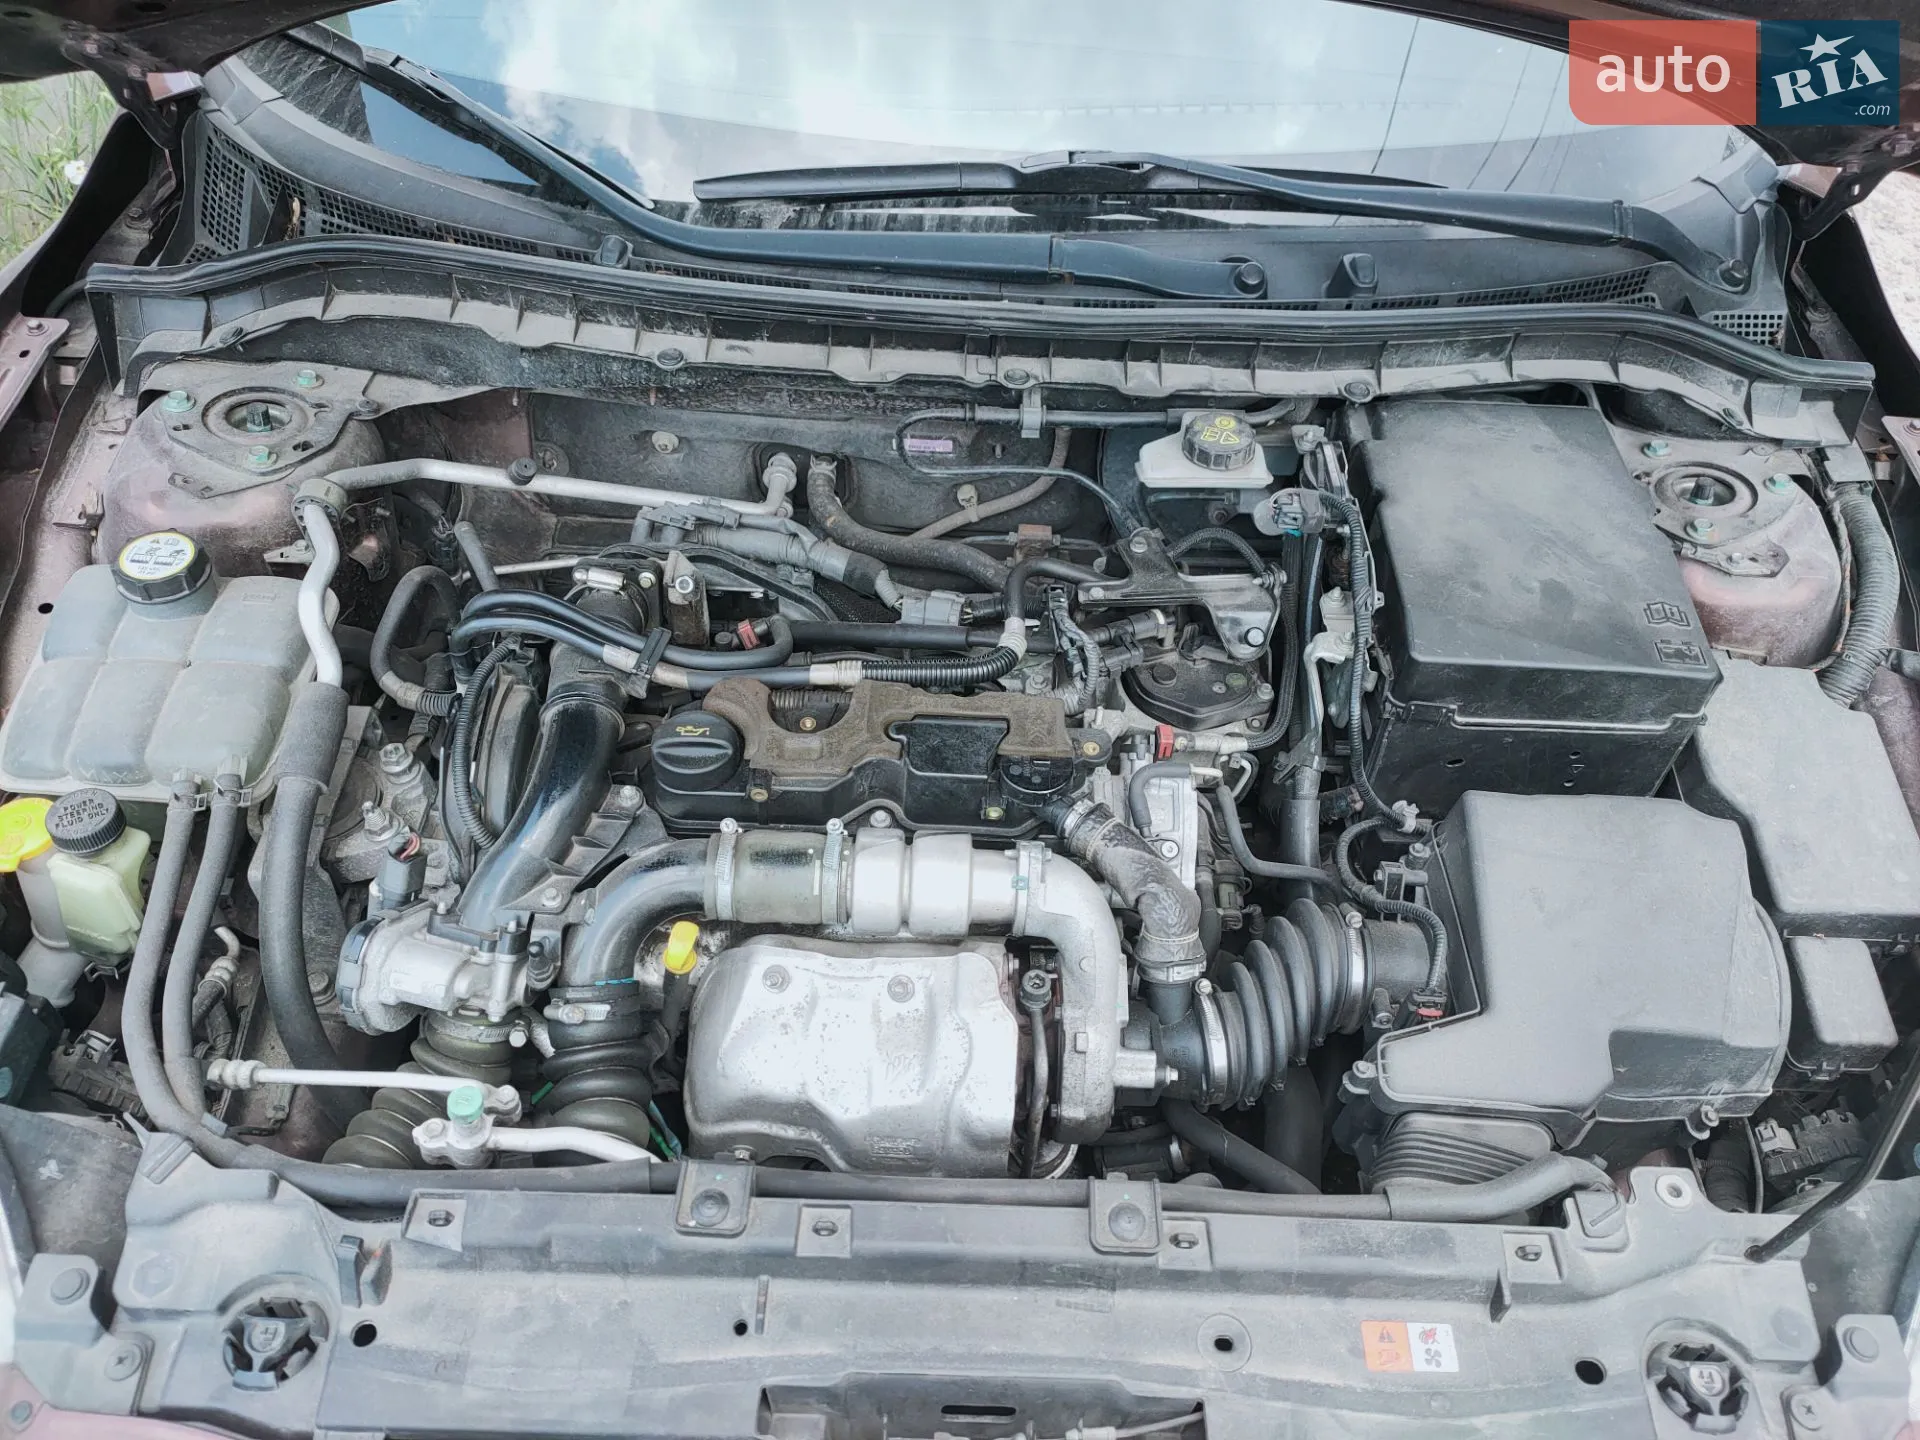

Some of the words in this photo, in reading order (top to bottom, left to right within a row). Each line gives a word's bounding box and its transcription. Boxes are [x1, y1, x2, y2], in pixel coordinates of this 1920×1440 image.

[63, 799, 95, 812] POWER
[55, 817, 84, 830] FLUID
[88, 808, 109, 820] ONLY
